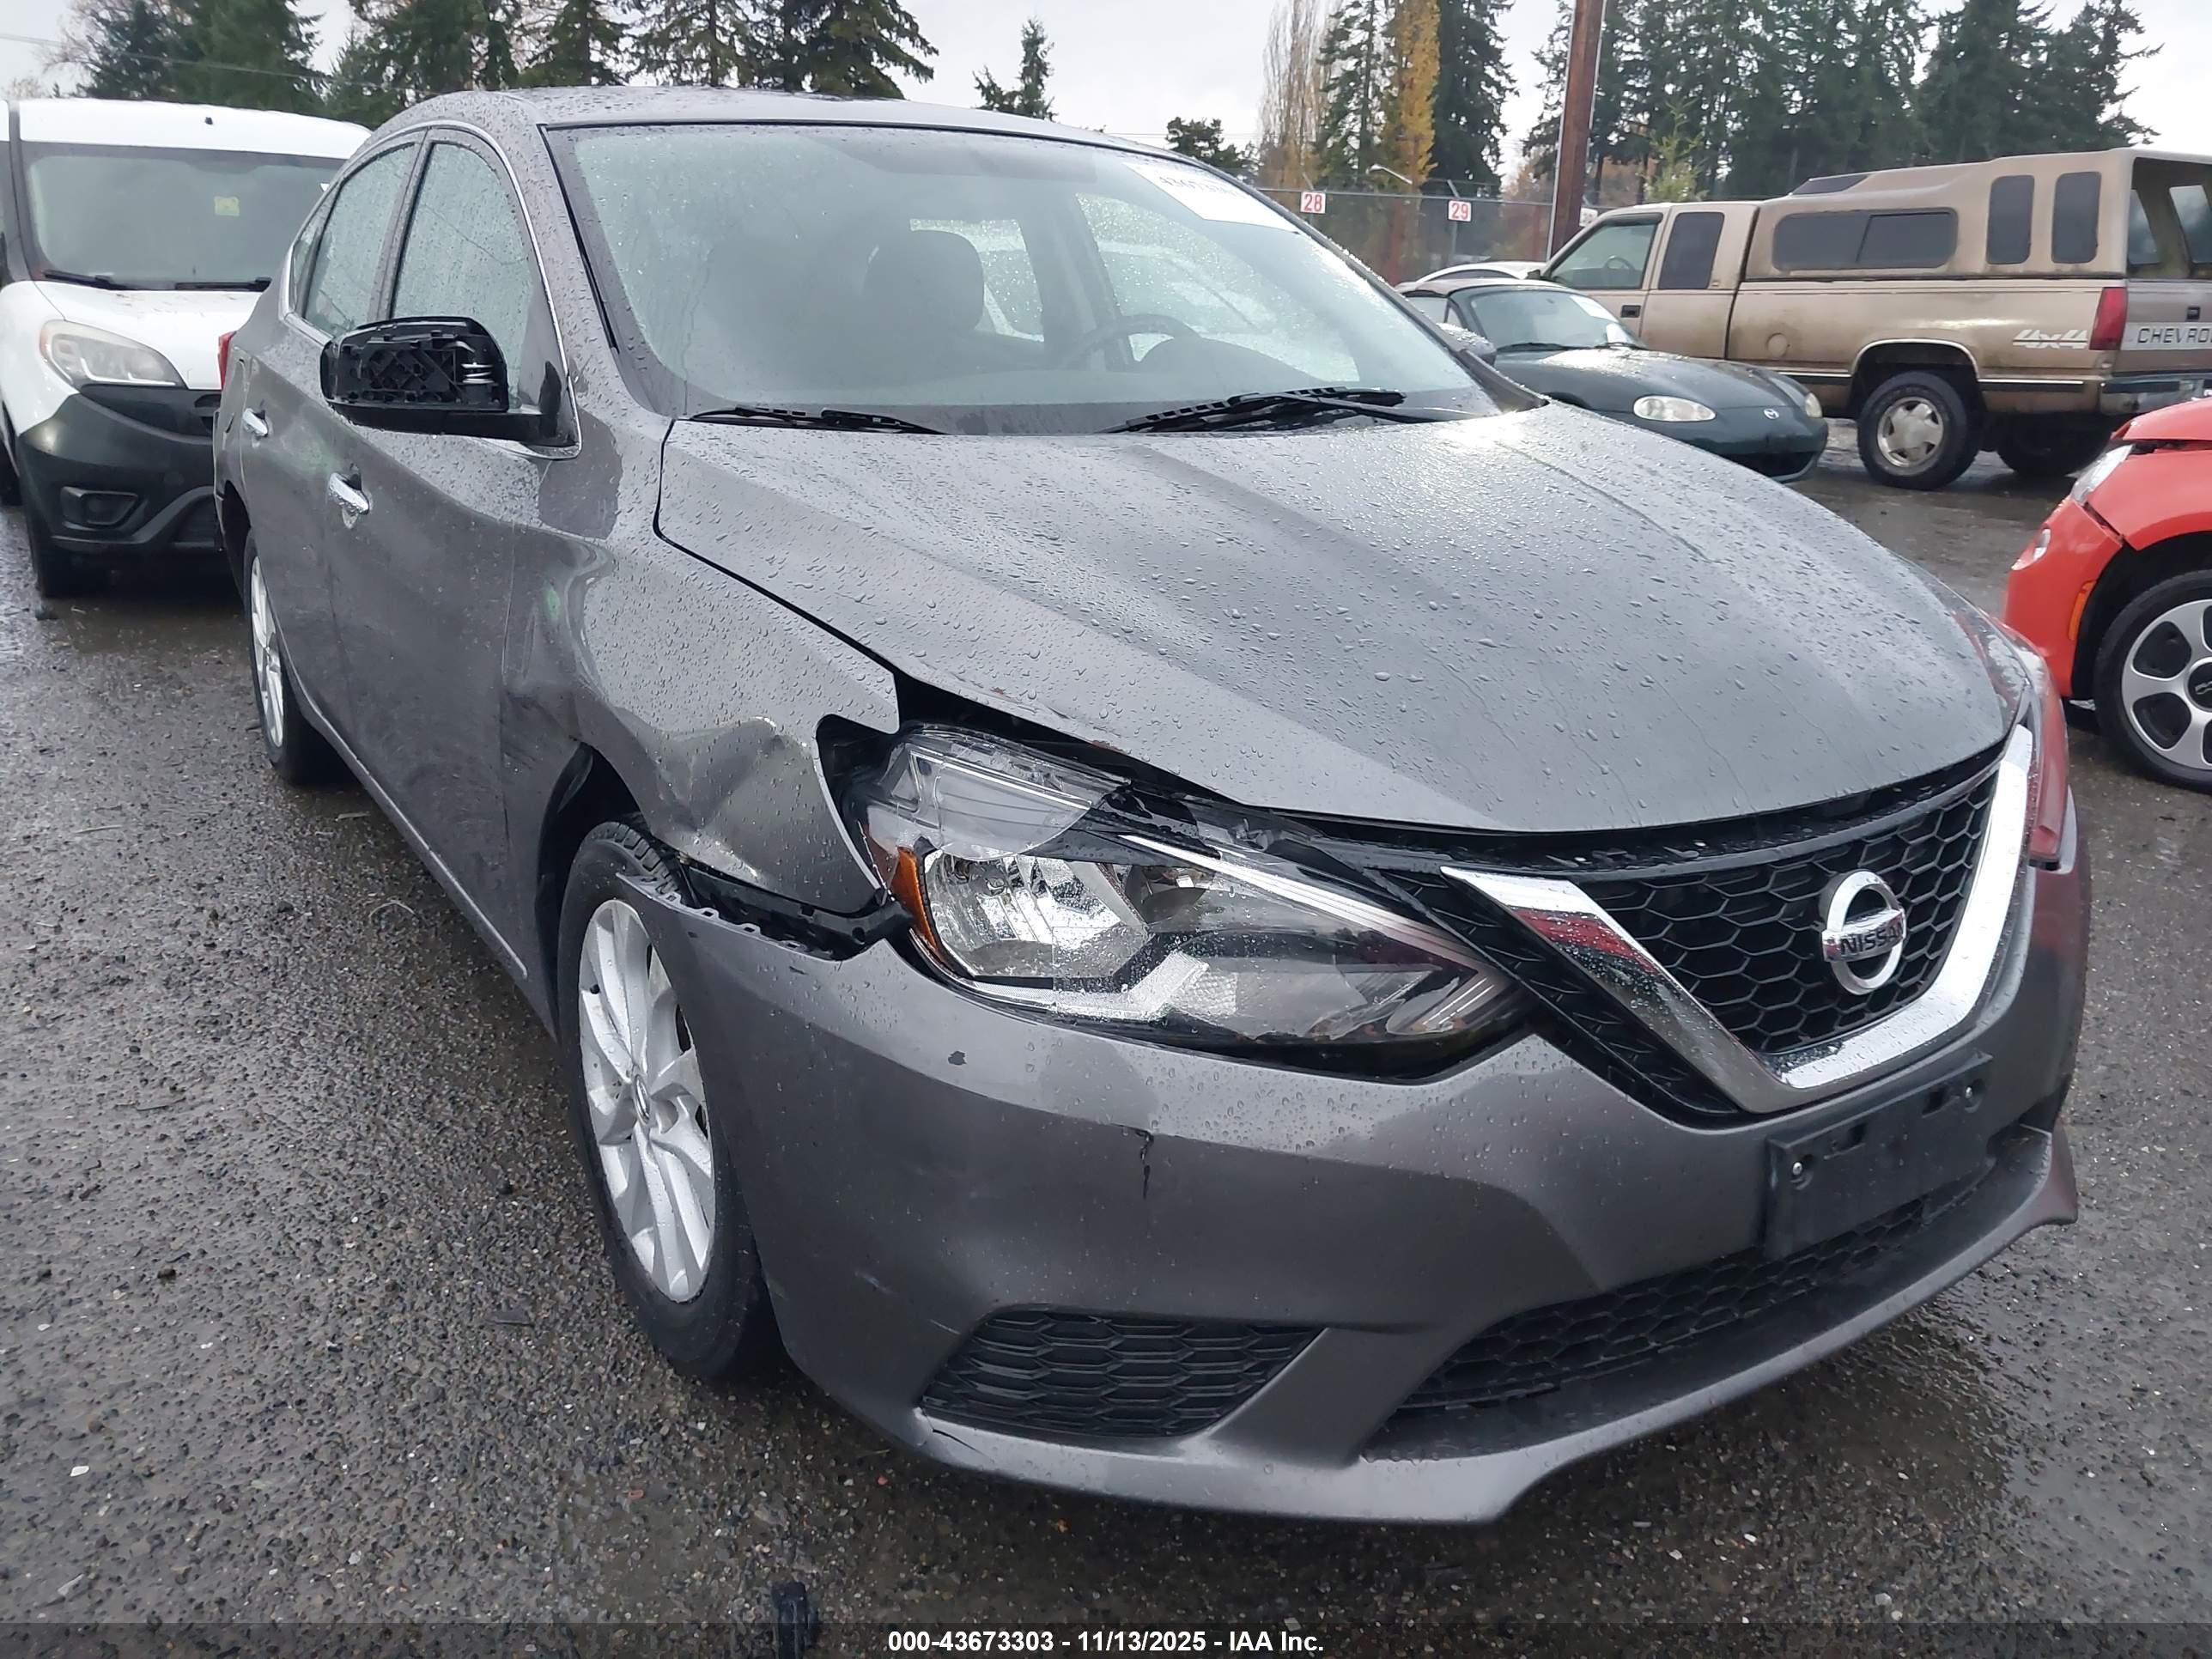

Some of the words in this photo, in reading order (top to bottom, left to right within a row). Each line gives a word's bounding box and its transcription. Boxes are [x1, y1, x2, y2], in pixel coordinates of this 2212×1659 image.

[1304, 193, 1322, 212] 28
[1451, 202, 1468, 220] 29
[2013, 330, 2087, 349] 4x4
[2137, 327, 2212, 343] CHEVRO
